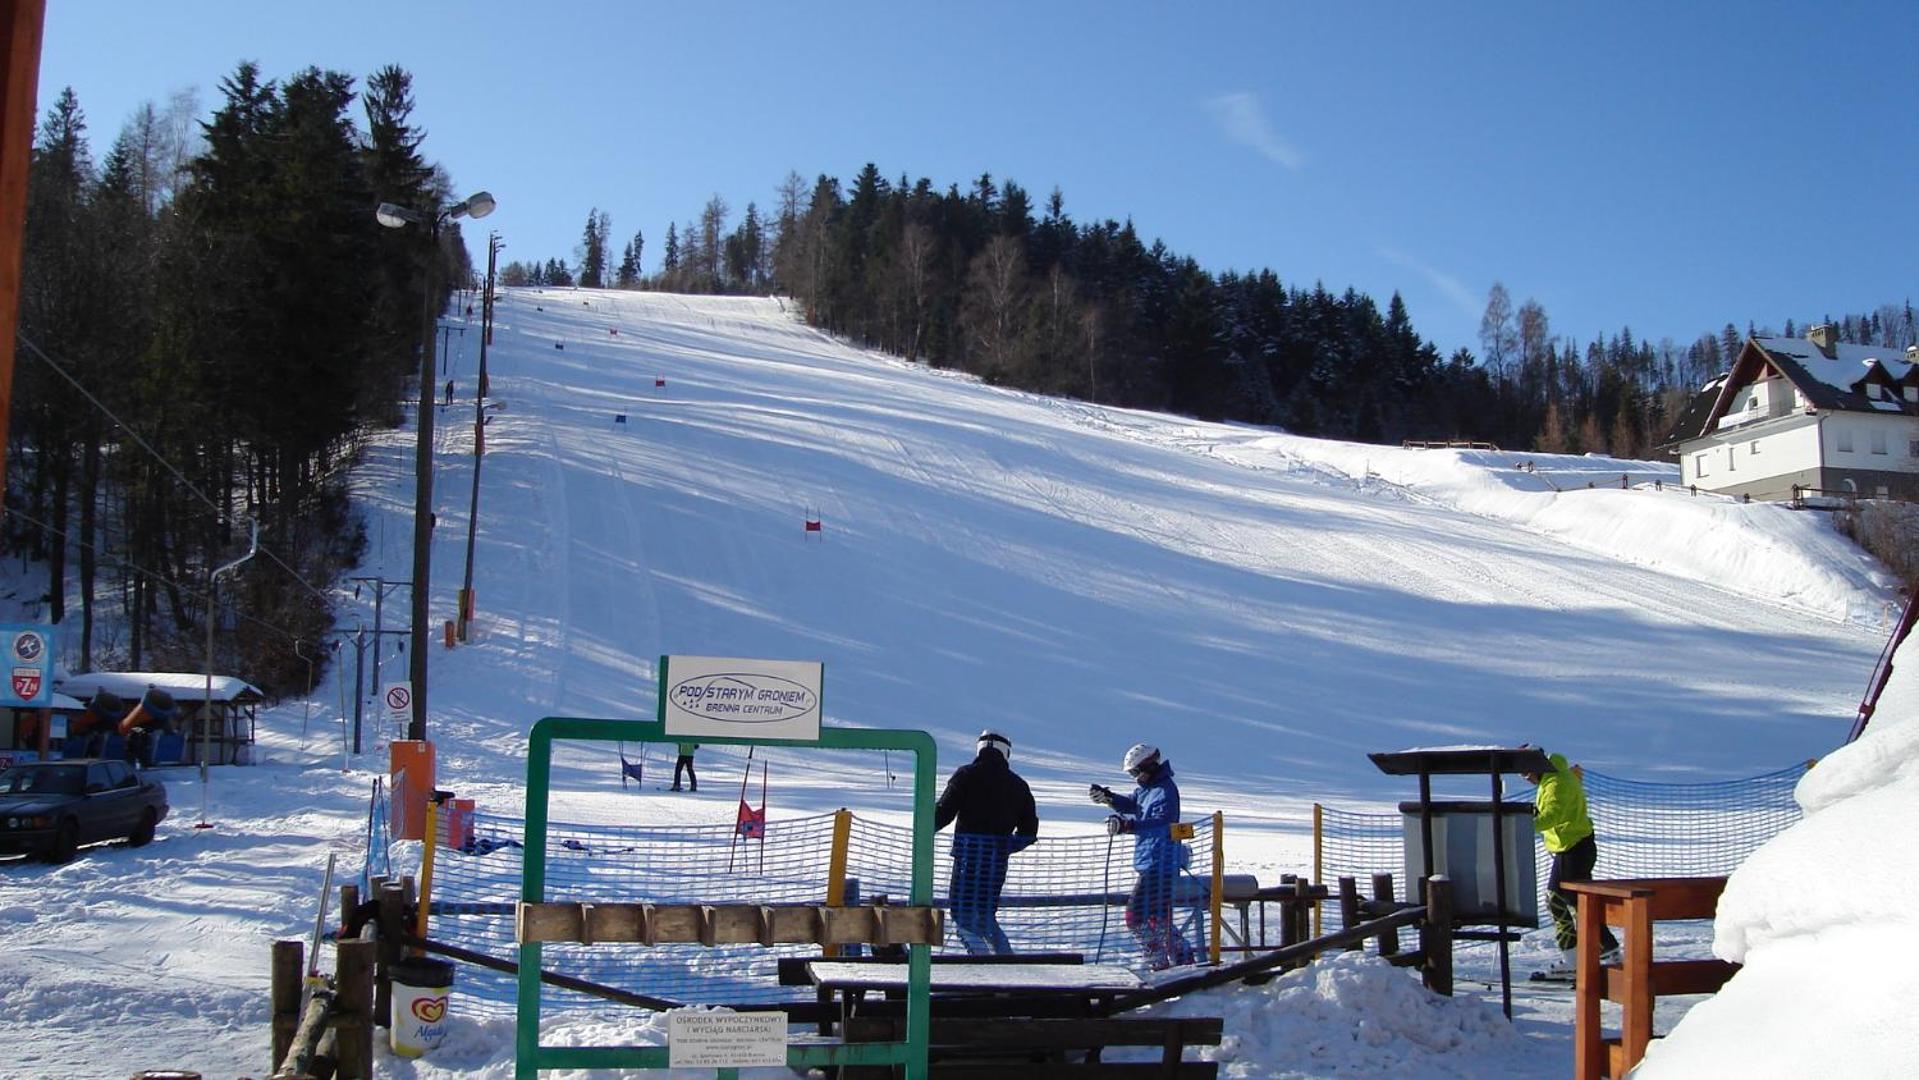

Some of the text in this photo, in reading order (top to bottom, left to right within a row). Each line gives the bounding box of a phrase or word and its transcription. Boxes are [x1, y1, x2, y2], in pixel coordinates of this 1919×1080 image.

[16, 678, 38, 696] PZN
[679, 686, 805, 702] POD STARYM GRONIEM
[706, 703, 783, 715] BRENNA CENTRUM
